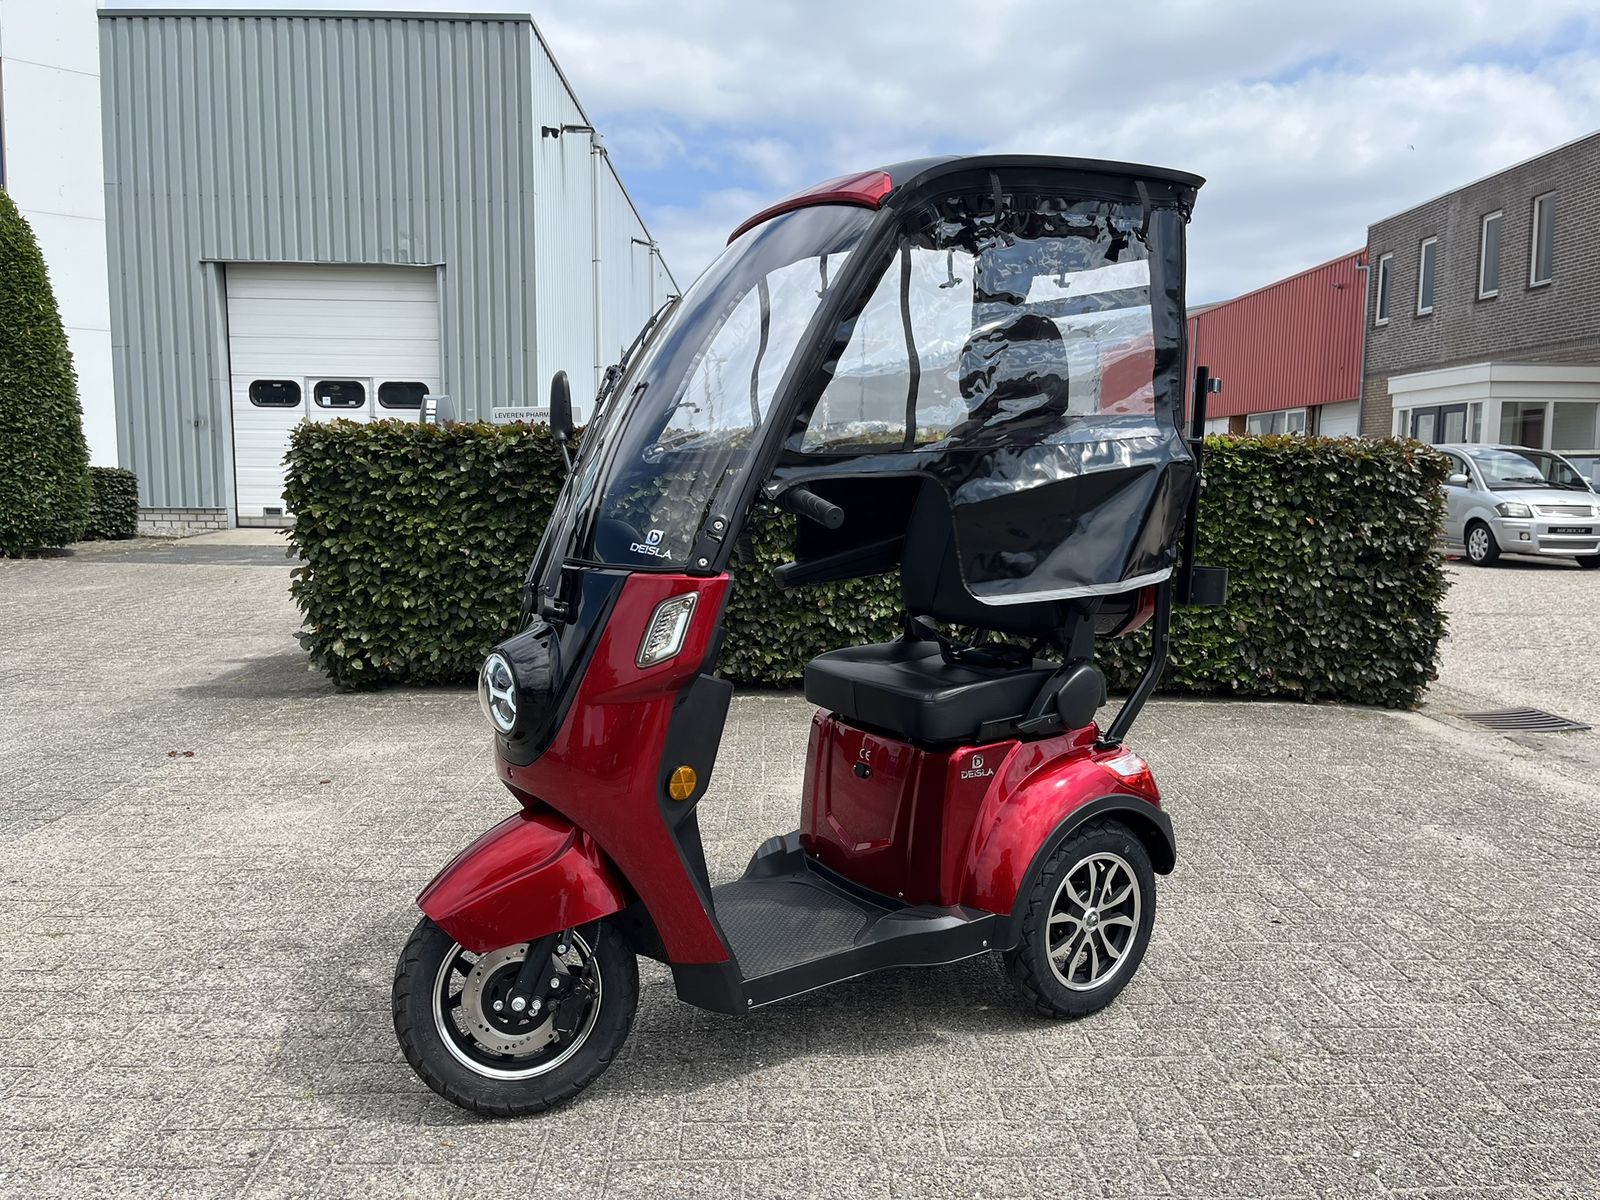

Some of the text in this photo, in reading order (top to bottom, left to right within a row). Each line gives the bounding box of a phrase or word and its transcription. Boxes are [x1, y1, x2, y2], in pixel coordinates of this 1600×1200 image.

[629, 542, 672, 560] DEISLA
[859, 748, 871, 761] CE
[960, 767, 994, 779] DEISLA
